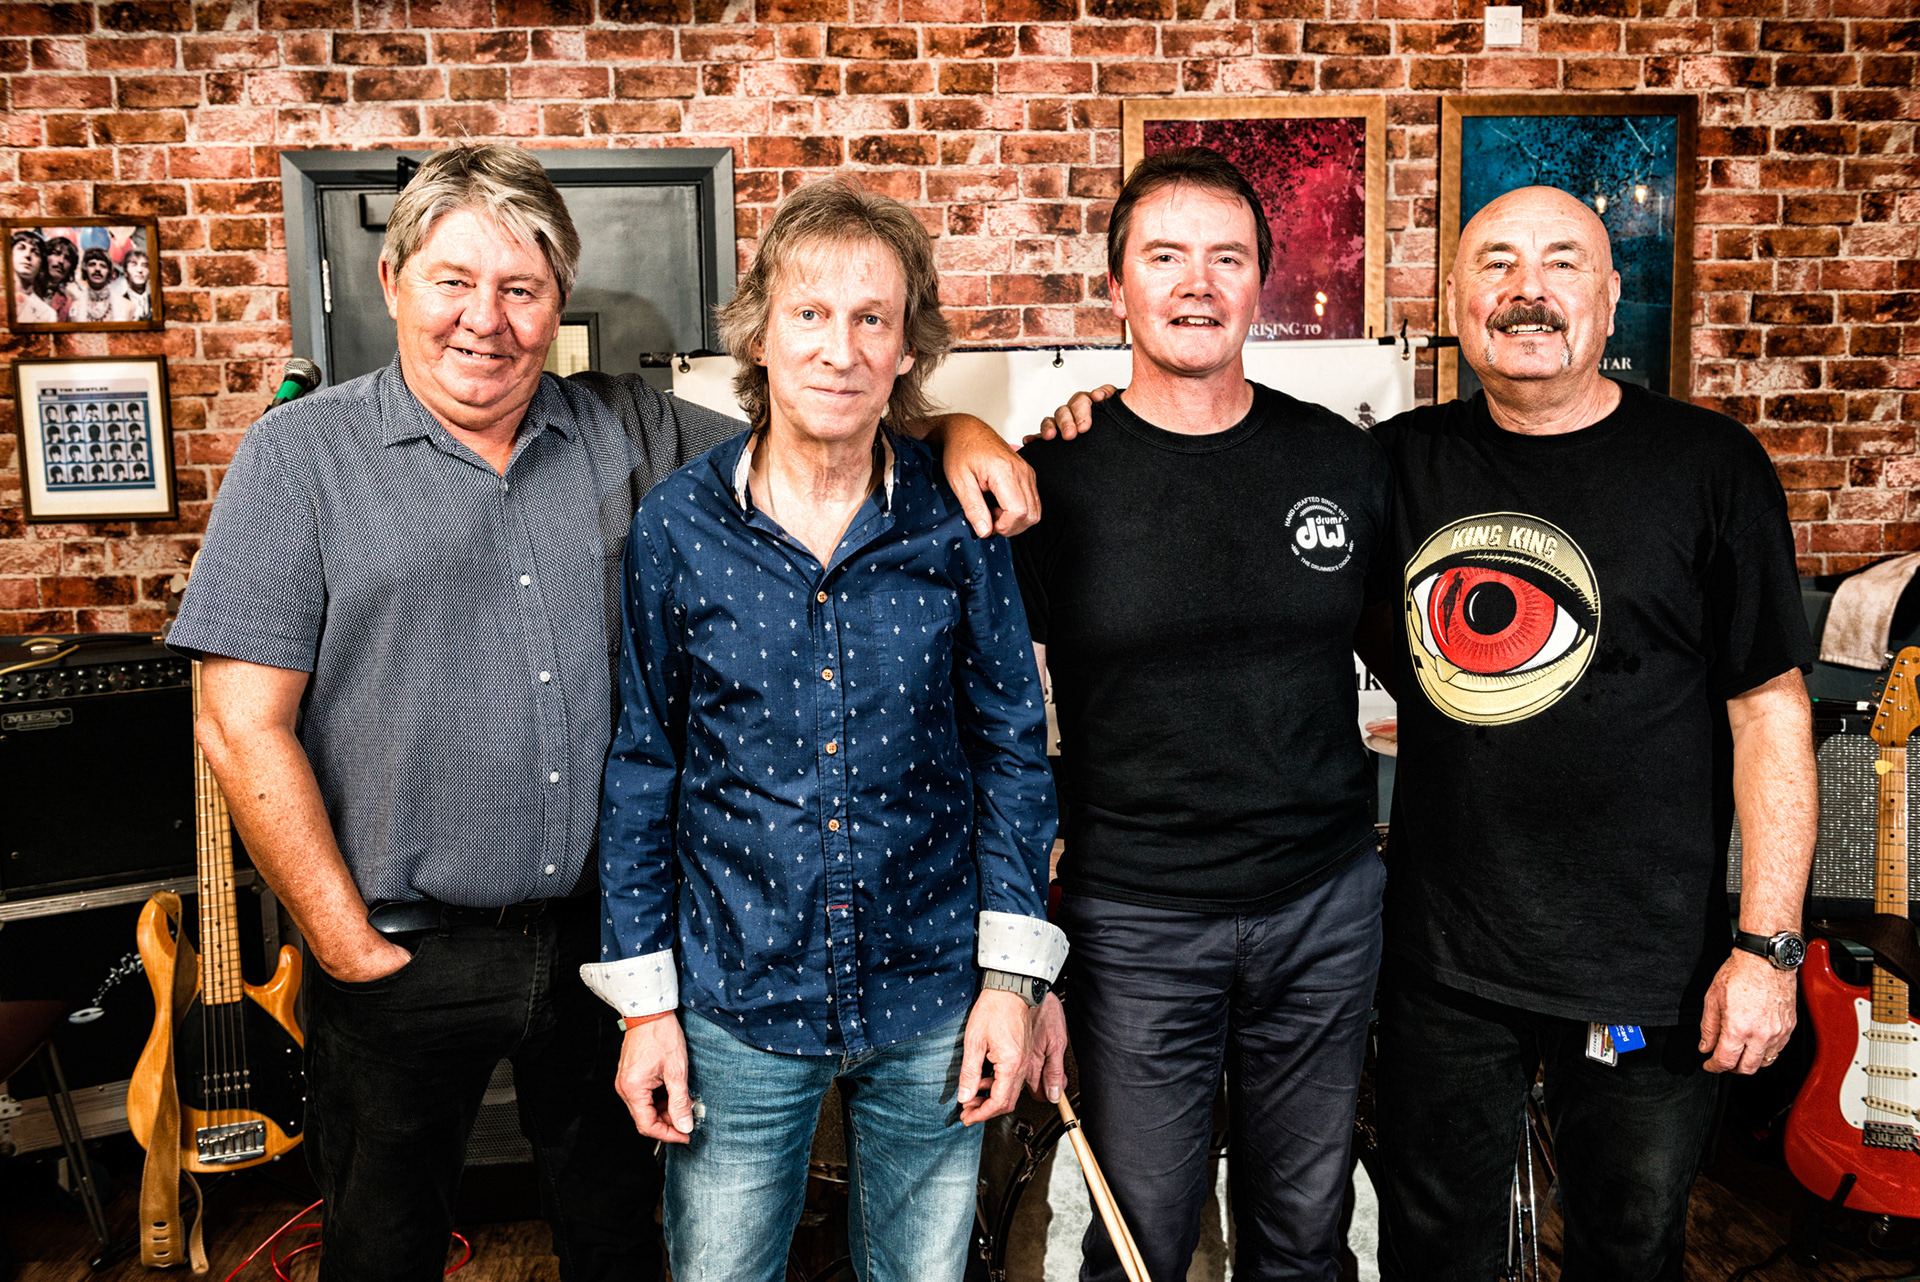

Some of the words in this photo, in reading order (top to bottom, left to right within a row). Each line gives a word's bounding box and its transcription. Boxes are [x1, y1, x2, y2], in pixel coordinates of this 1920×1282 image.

[1249, 322, 1300, 337] RISING
[1302, 323, 1322, 336] TO
[1284, 508, 1296, 527] HAND
[1293, 496, 1320, 511] CRAFTED
[1320, 497, 1339, 511] SINCE
[1315, 515, 1342, 525] drums
[1295, 517, 1346, 550] dw
[1450, 524, 1503, 551] KING
[1507, 525, 1558, 561] KING
[1301, 557, 1311, 568] THE
[7, 711, 67, 723] MESA
